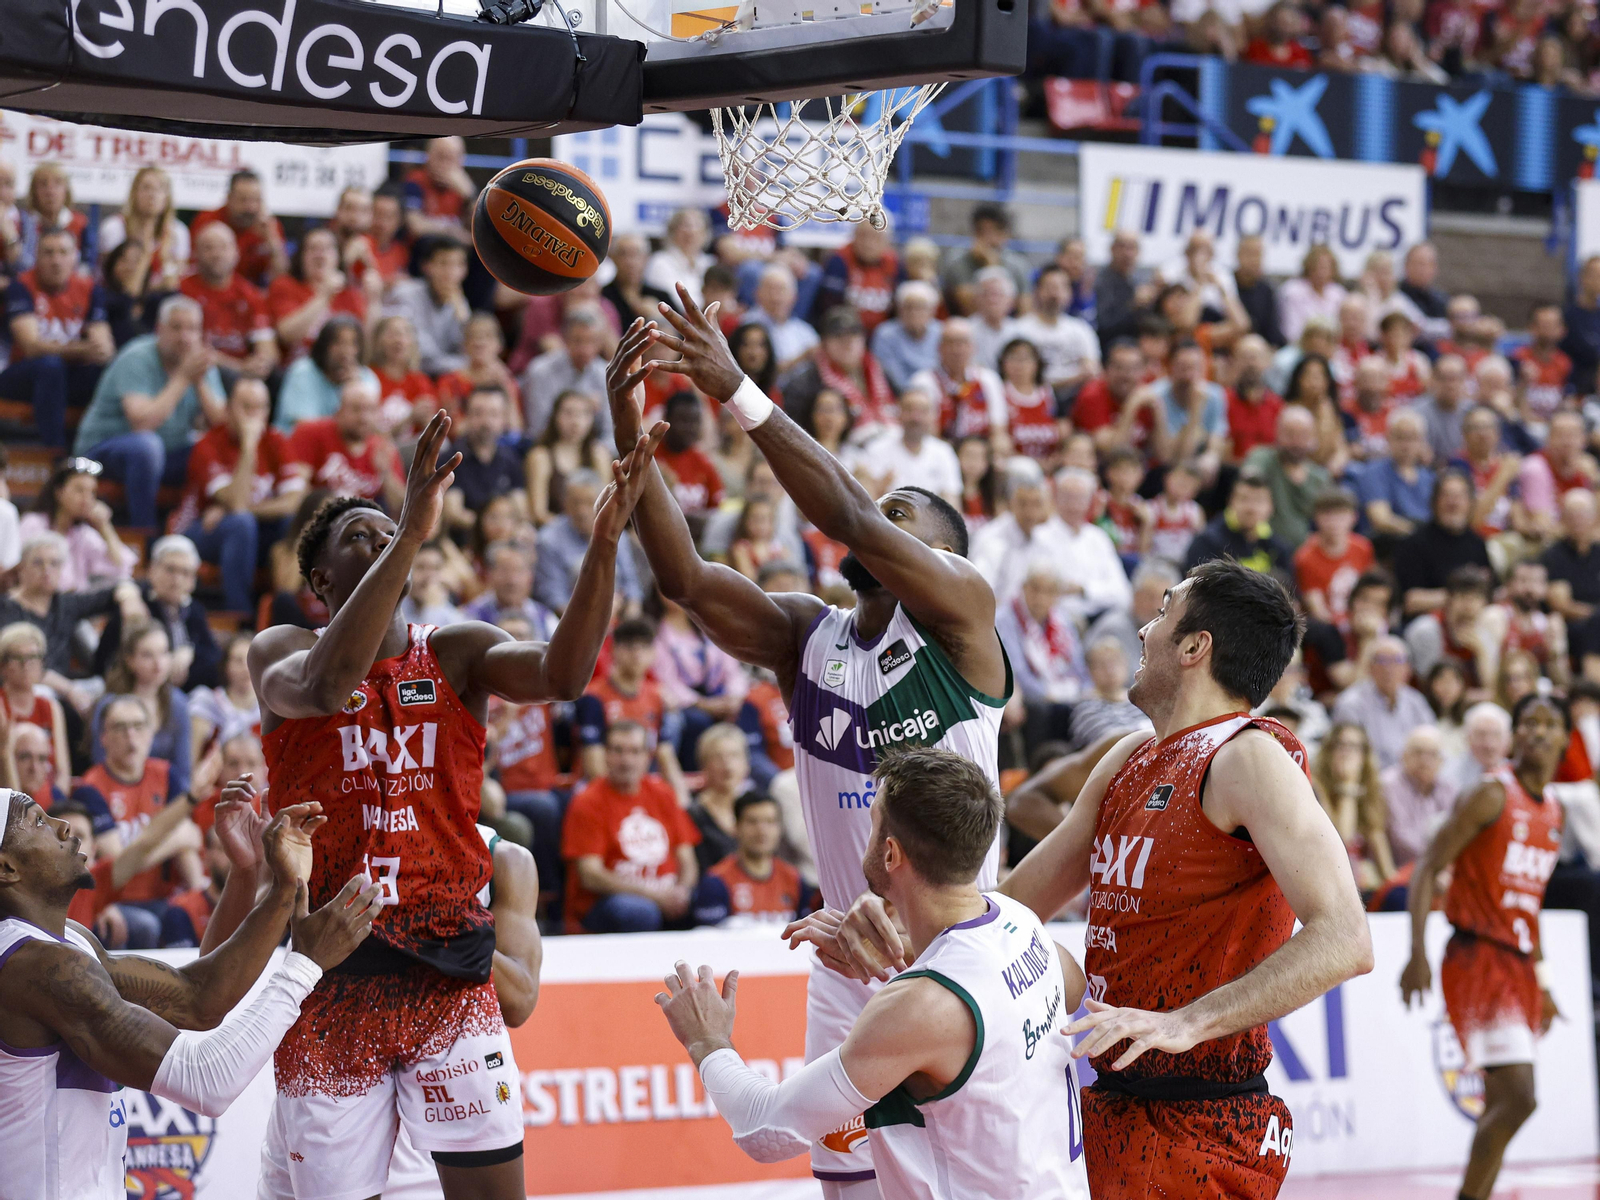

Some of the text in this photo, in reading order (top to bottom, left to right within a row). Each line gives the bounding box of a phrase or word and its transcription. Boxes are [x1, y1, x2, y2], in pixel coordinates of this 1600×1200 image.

[72, 0, 492, 116] endesa
[500, 200, 585, 268] SPALDING
[337, 721, 438, 774] BAXI
[362, 803, 420, 833] MARESA
[1089, 833, 1155, 890] AXI
[421, 1084, 455, 1103] ETL
[424, 1099, 492, 1123] GLOBAL
[520, 1062, 720, 1127] STRELL
